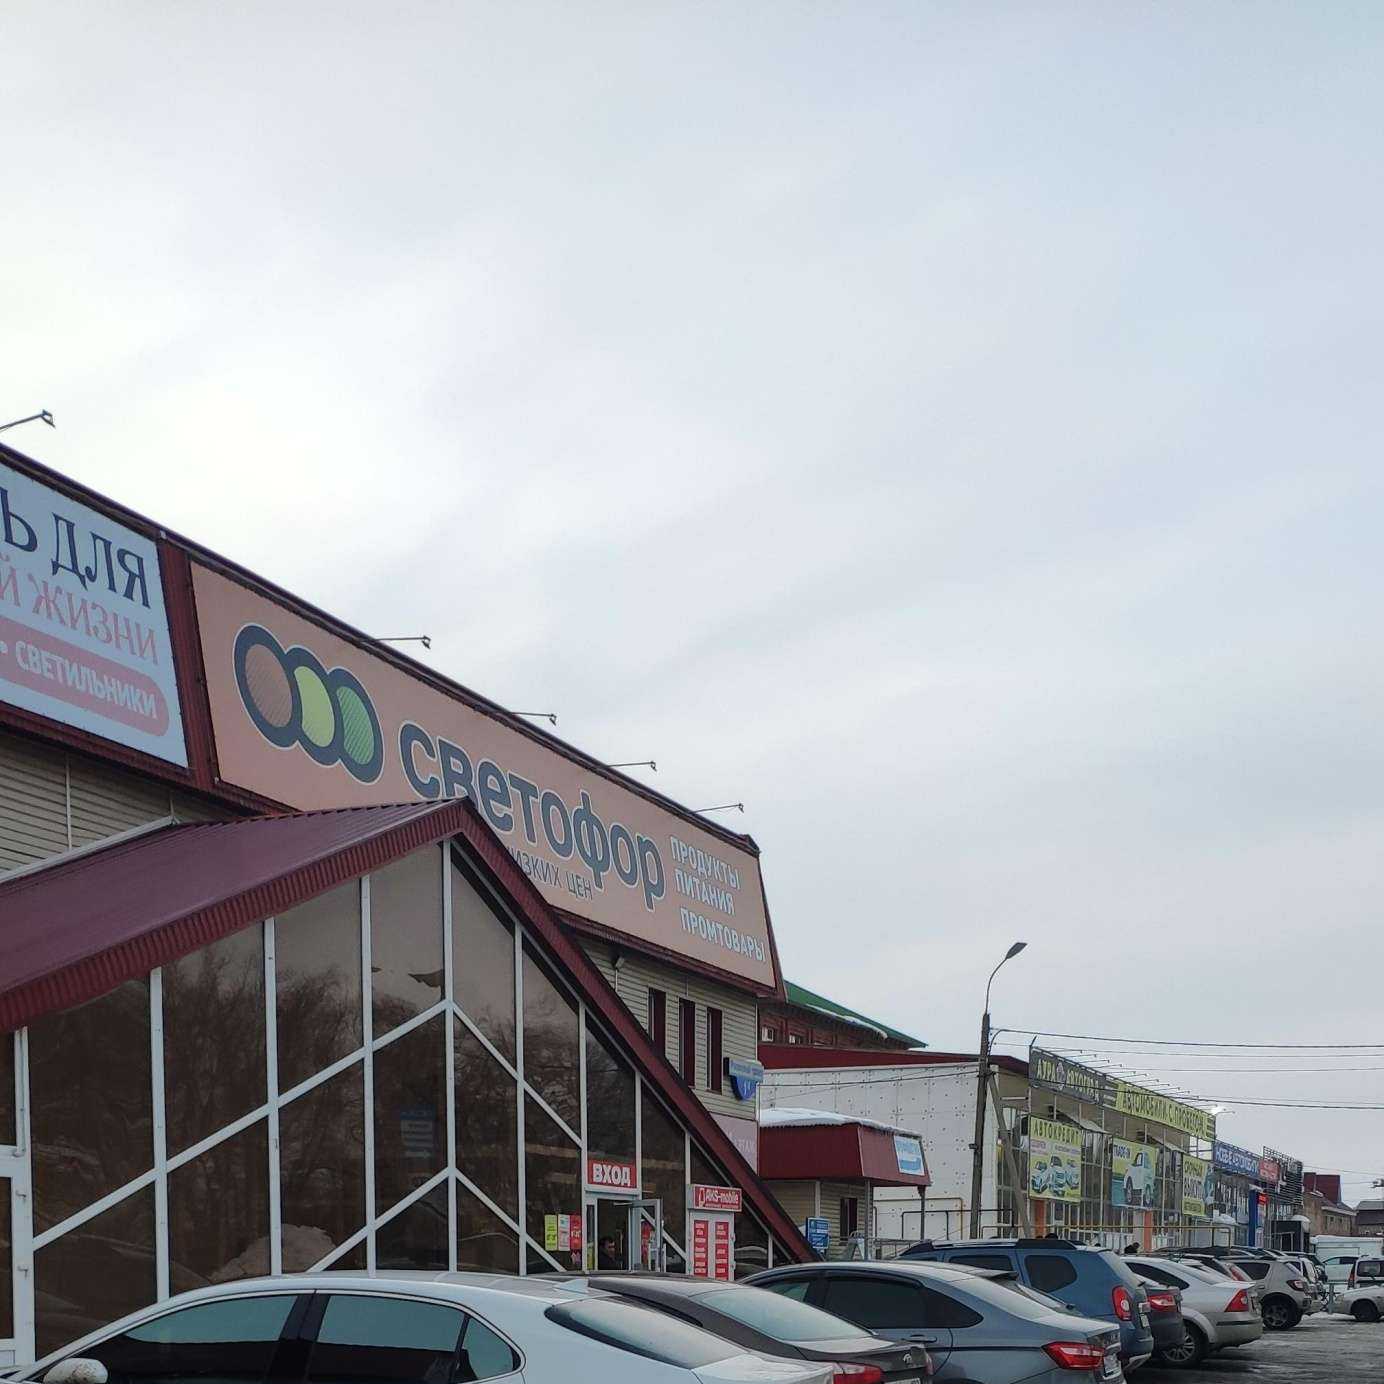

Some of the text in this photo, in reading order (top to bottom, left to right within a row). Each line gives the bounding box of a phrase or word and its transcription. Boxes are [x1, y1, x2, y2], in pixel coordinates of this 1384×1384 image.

[51, 512, 150, 609] ДЛЯ
[27, 573, 158, 665] ЖИЗНИ
[15, 640, 157, 719] СВЕТИЛЬНИКИ
[507, 846, 593, 900] ИЗКИХ ЦЕН
[670, 836, 741, 890] ПРОДУКТЫ
[675, 868, 735, 915] ПИТАНИЯ
[680, 906, 766, 962] ПРОМТОВАРЫ
[593, 1163, 631, 1187] ВХОД
